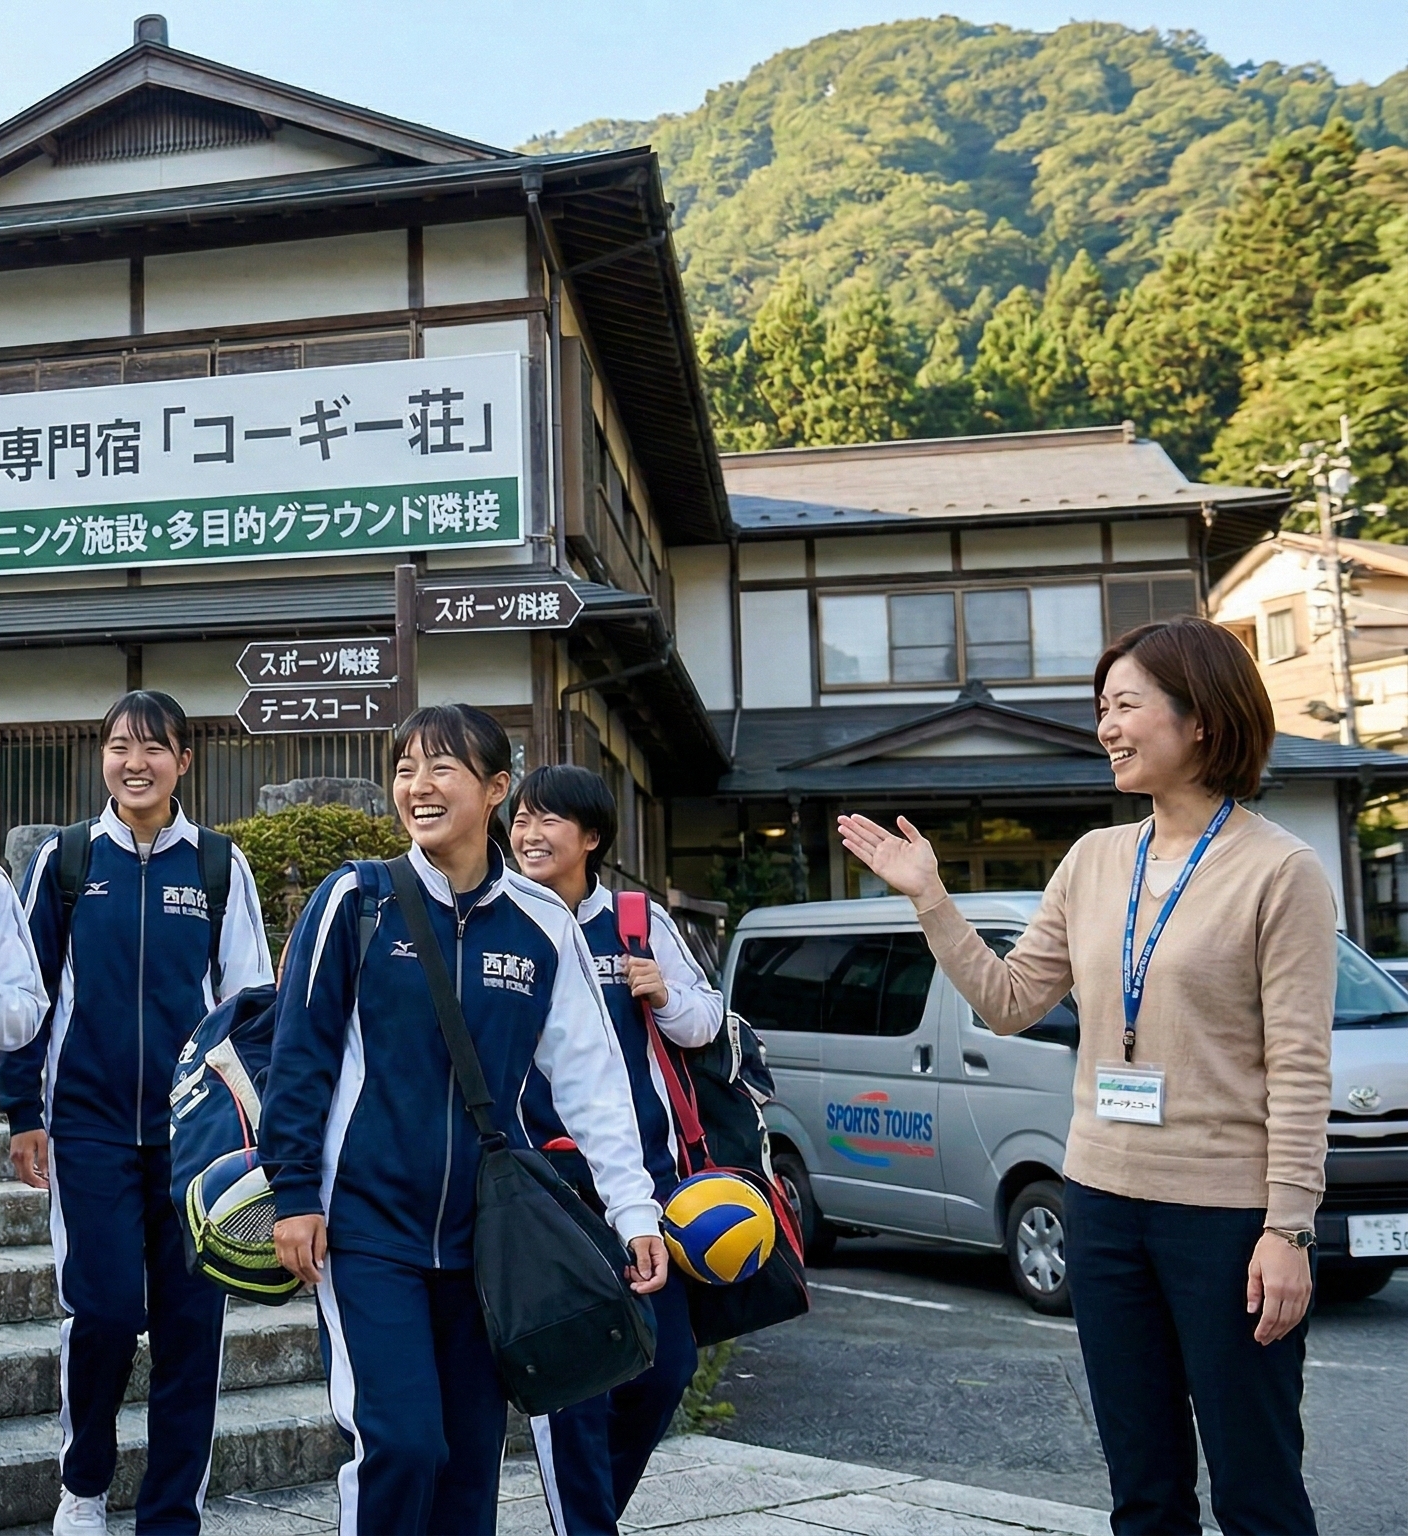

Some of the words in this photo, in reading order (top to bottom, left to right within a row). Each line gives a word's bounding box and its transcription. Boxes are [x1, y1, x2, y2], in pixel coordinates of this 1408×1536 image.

[260, 694, 380, 723] テニスコート
[826, 1102, 880, 1136] SPORTS
[884, 1109, 933, 1142] TOURS
